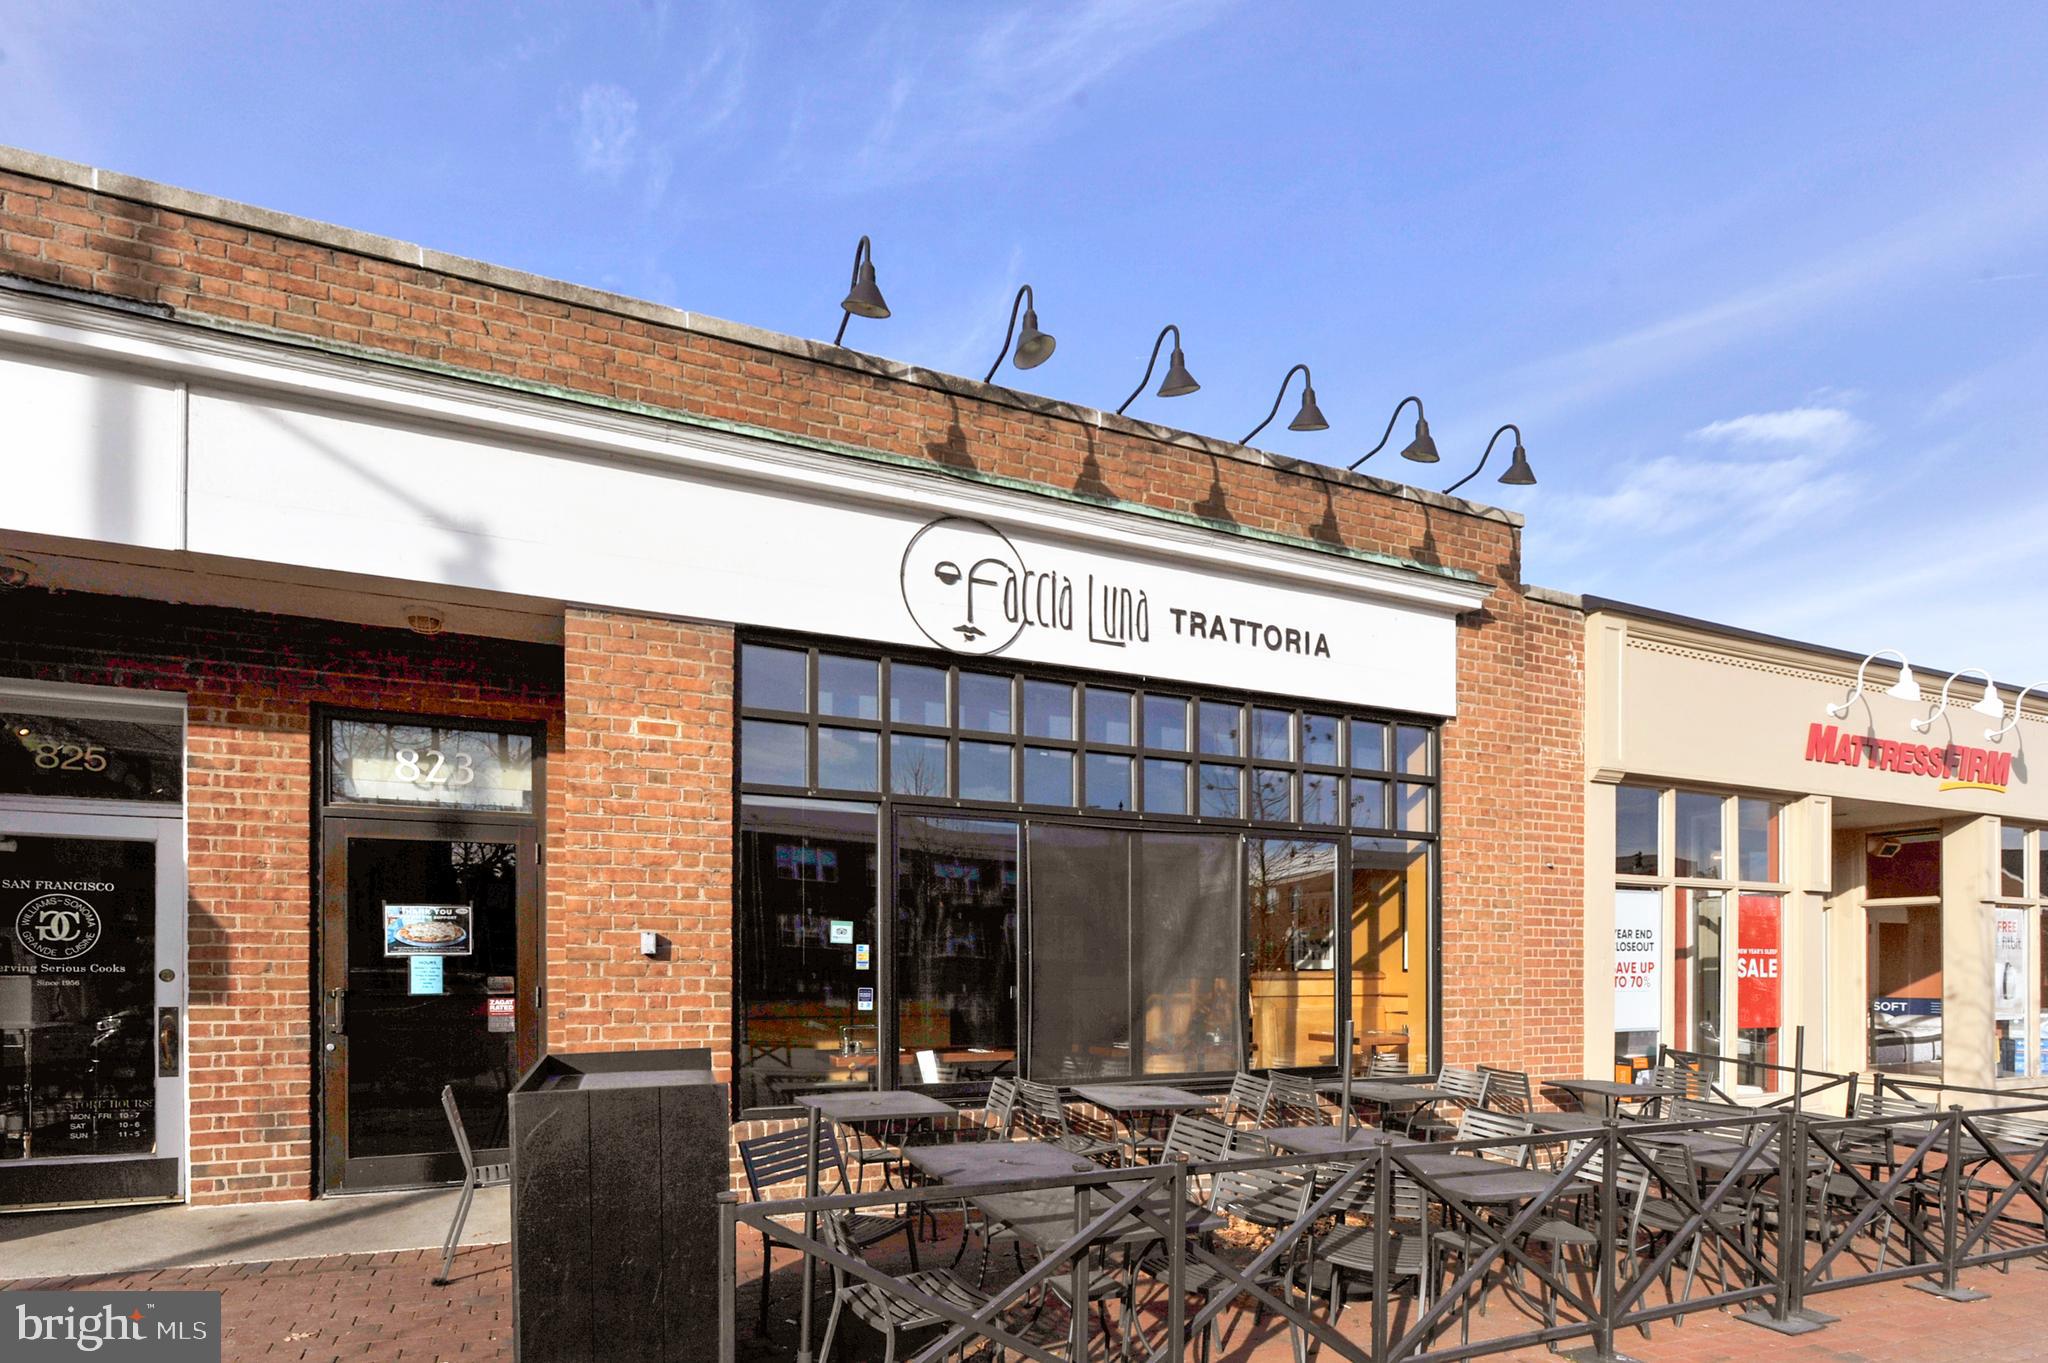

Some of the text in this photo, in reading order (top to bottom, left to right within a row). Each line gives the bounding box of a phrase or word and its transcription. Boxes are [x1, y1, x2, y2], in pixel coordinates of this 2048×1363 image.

[1089, 573, 1149, 648] Luna
[1170, 607, 1331, 658] TRATTORIA
[35, 743, 107, 772] 825
[395, 749, 475, 785] 823
[2, 880, 115, 892] SAN FRANCISCO
[21, 897, 96, 928] WILLIAMS-SONOMA
[434, 908, 453, 916] YOU
[1997, 920, 2017, 933] FREE
[1635, 929, 1653, 939] END
[22, 930, 96, 957] GRANDE CUISINE
[1615, 941, 1655, 952] LOSEOUT
[0, 962, 126, 975] erving Serious Cooks
[1615, 961, 1655, 974] AVE UP
[1737, 957, 1778, 978] SALE
[1873, 1001, 1908, 1012] SOFT
[70, 1122, 86, 1130] SAT
[70, 1132, 89, 1140] SUN
